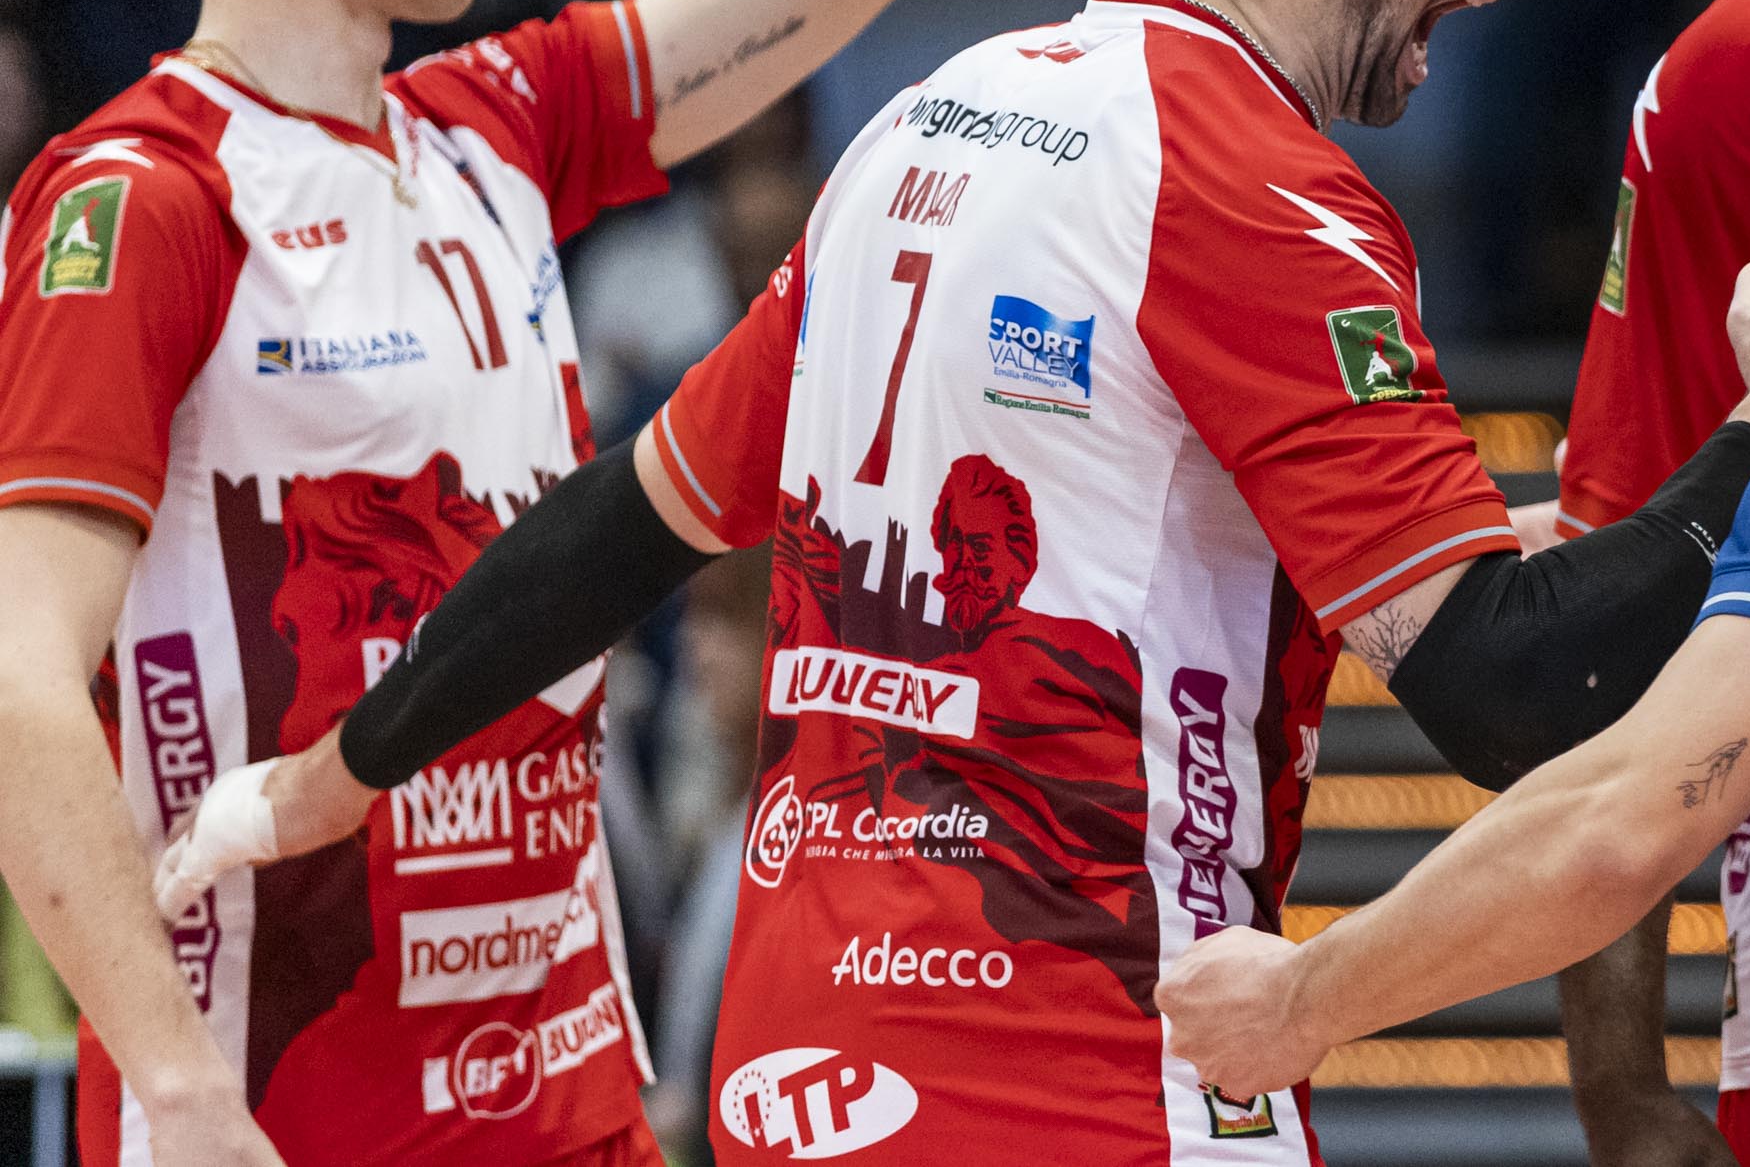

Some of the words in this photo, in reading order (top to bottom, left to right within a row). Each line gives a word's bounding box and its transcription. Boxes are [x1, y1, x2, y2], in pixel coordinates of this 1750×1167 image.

[271, 218, 348, 250] eus
[414, 238, 510, 372] 17
[989, 317, 1082, 359] SPORT
[853, 249, 933, 487] 7
[988, 341, 1079, 379] VALLEY
[923, 847, 943, 859] LA
[950, 847, 985, 859] VITA
[831, 931, 1014, 989] Adecco
